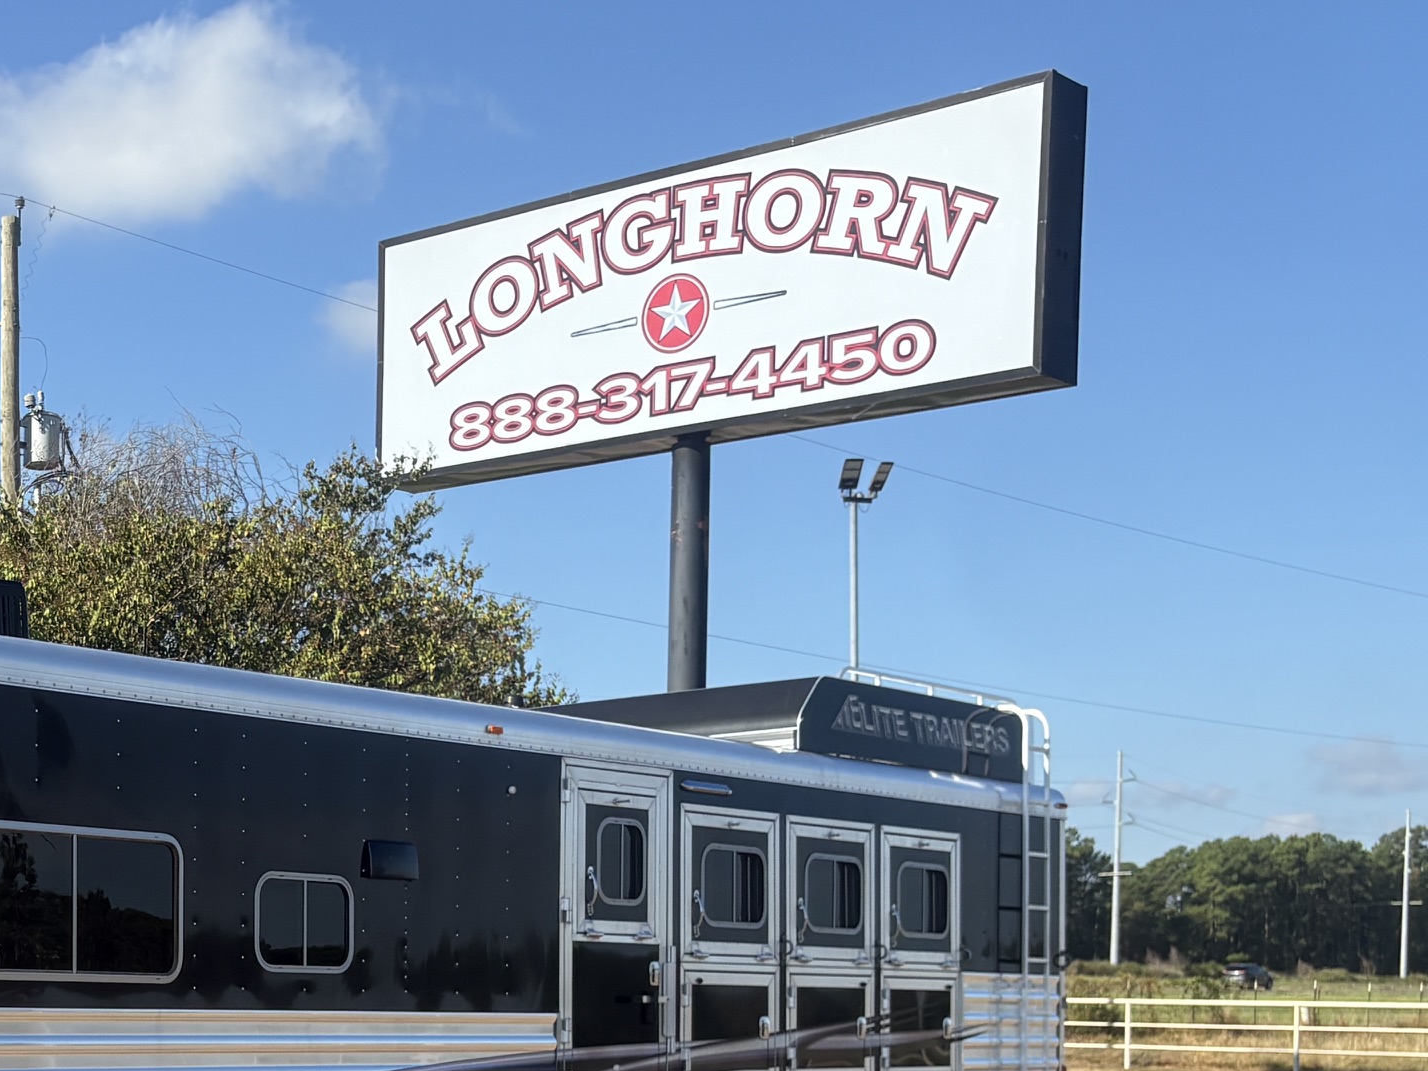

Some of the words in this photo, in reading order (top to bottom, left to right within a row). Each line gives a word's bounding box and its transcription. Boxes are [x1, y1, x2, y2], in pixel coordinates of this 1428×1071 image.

[410, 169, 998, 385] LONGHORN
[449, 319, 936, 451] 888-317-4450
[910, 711, 1010, 754] TRAILERS
